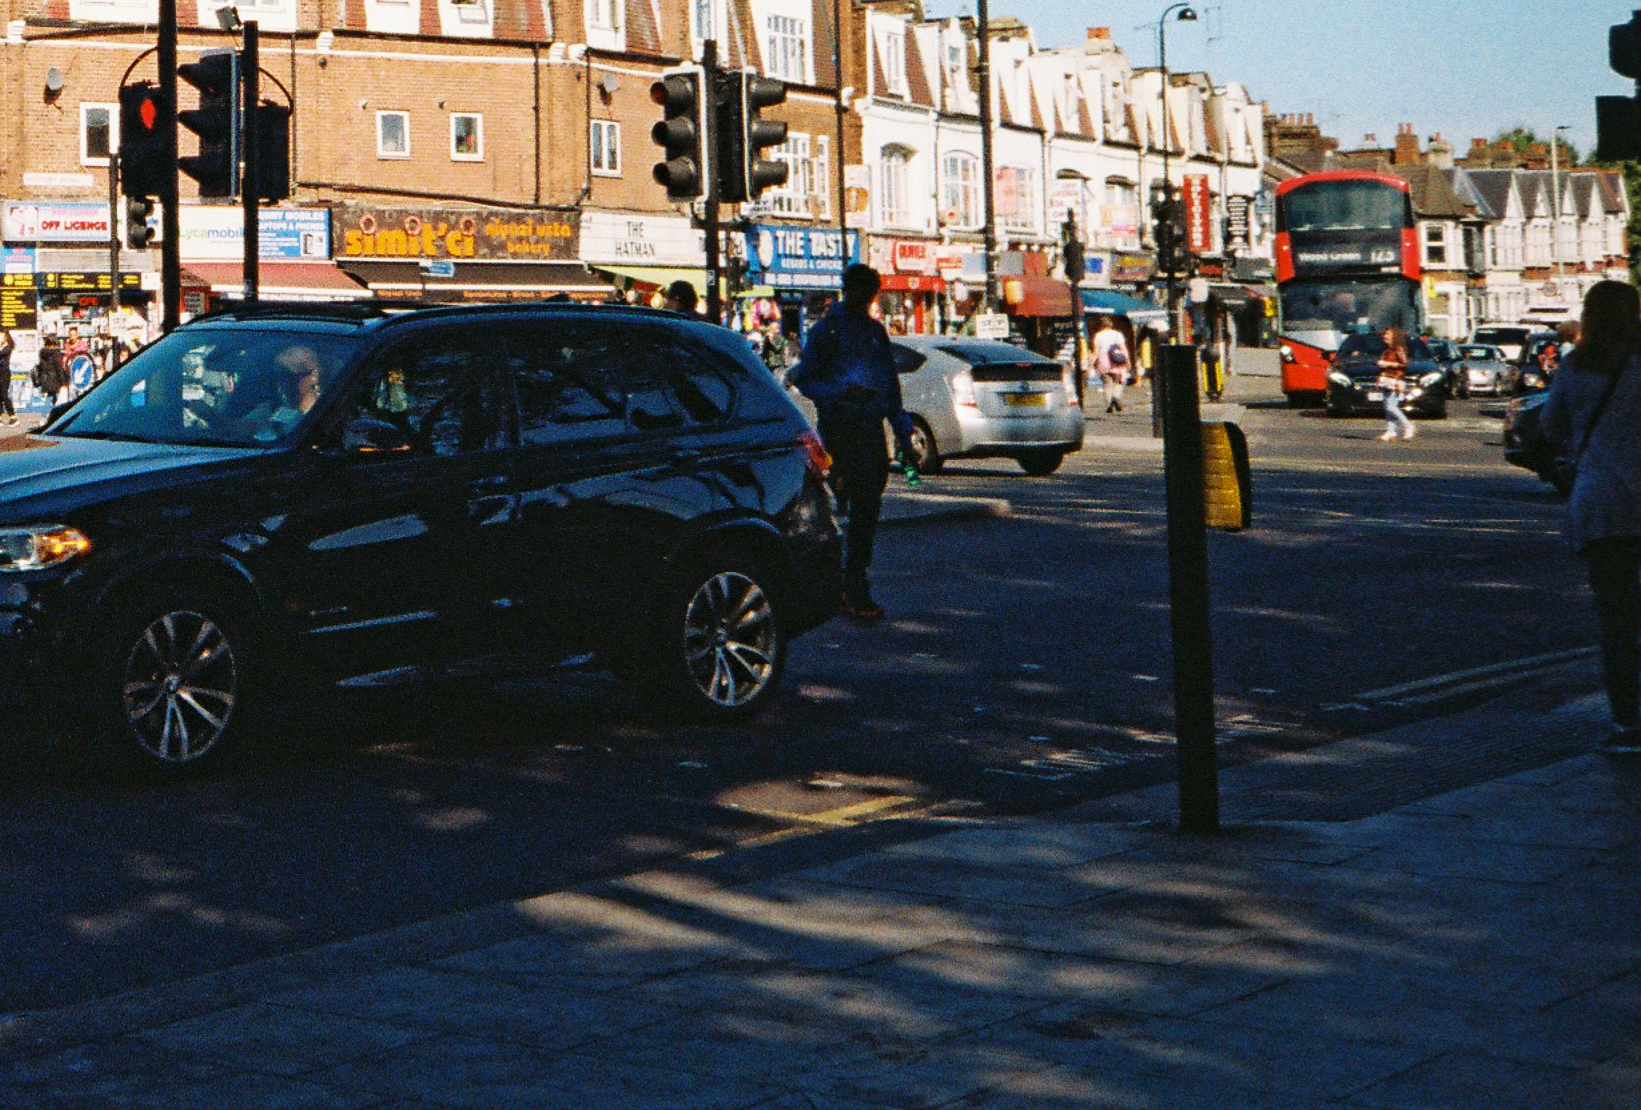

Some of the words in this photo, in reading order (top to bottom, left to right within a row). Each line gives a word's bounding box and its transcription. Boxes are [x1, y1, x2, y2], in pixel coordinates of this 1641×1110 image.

[41, 221, 60, 231] OFF
[64, 221, 108, 231] LICENCE
[626, 221, 644, 238] THE
[615, 242, 655, 258] HATMAN
[775, 231, 805, 255] THE
[808, 232, 857, 256] TASTY
[816, 259, 844, 269] CHICKE
